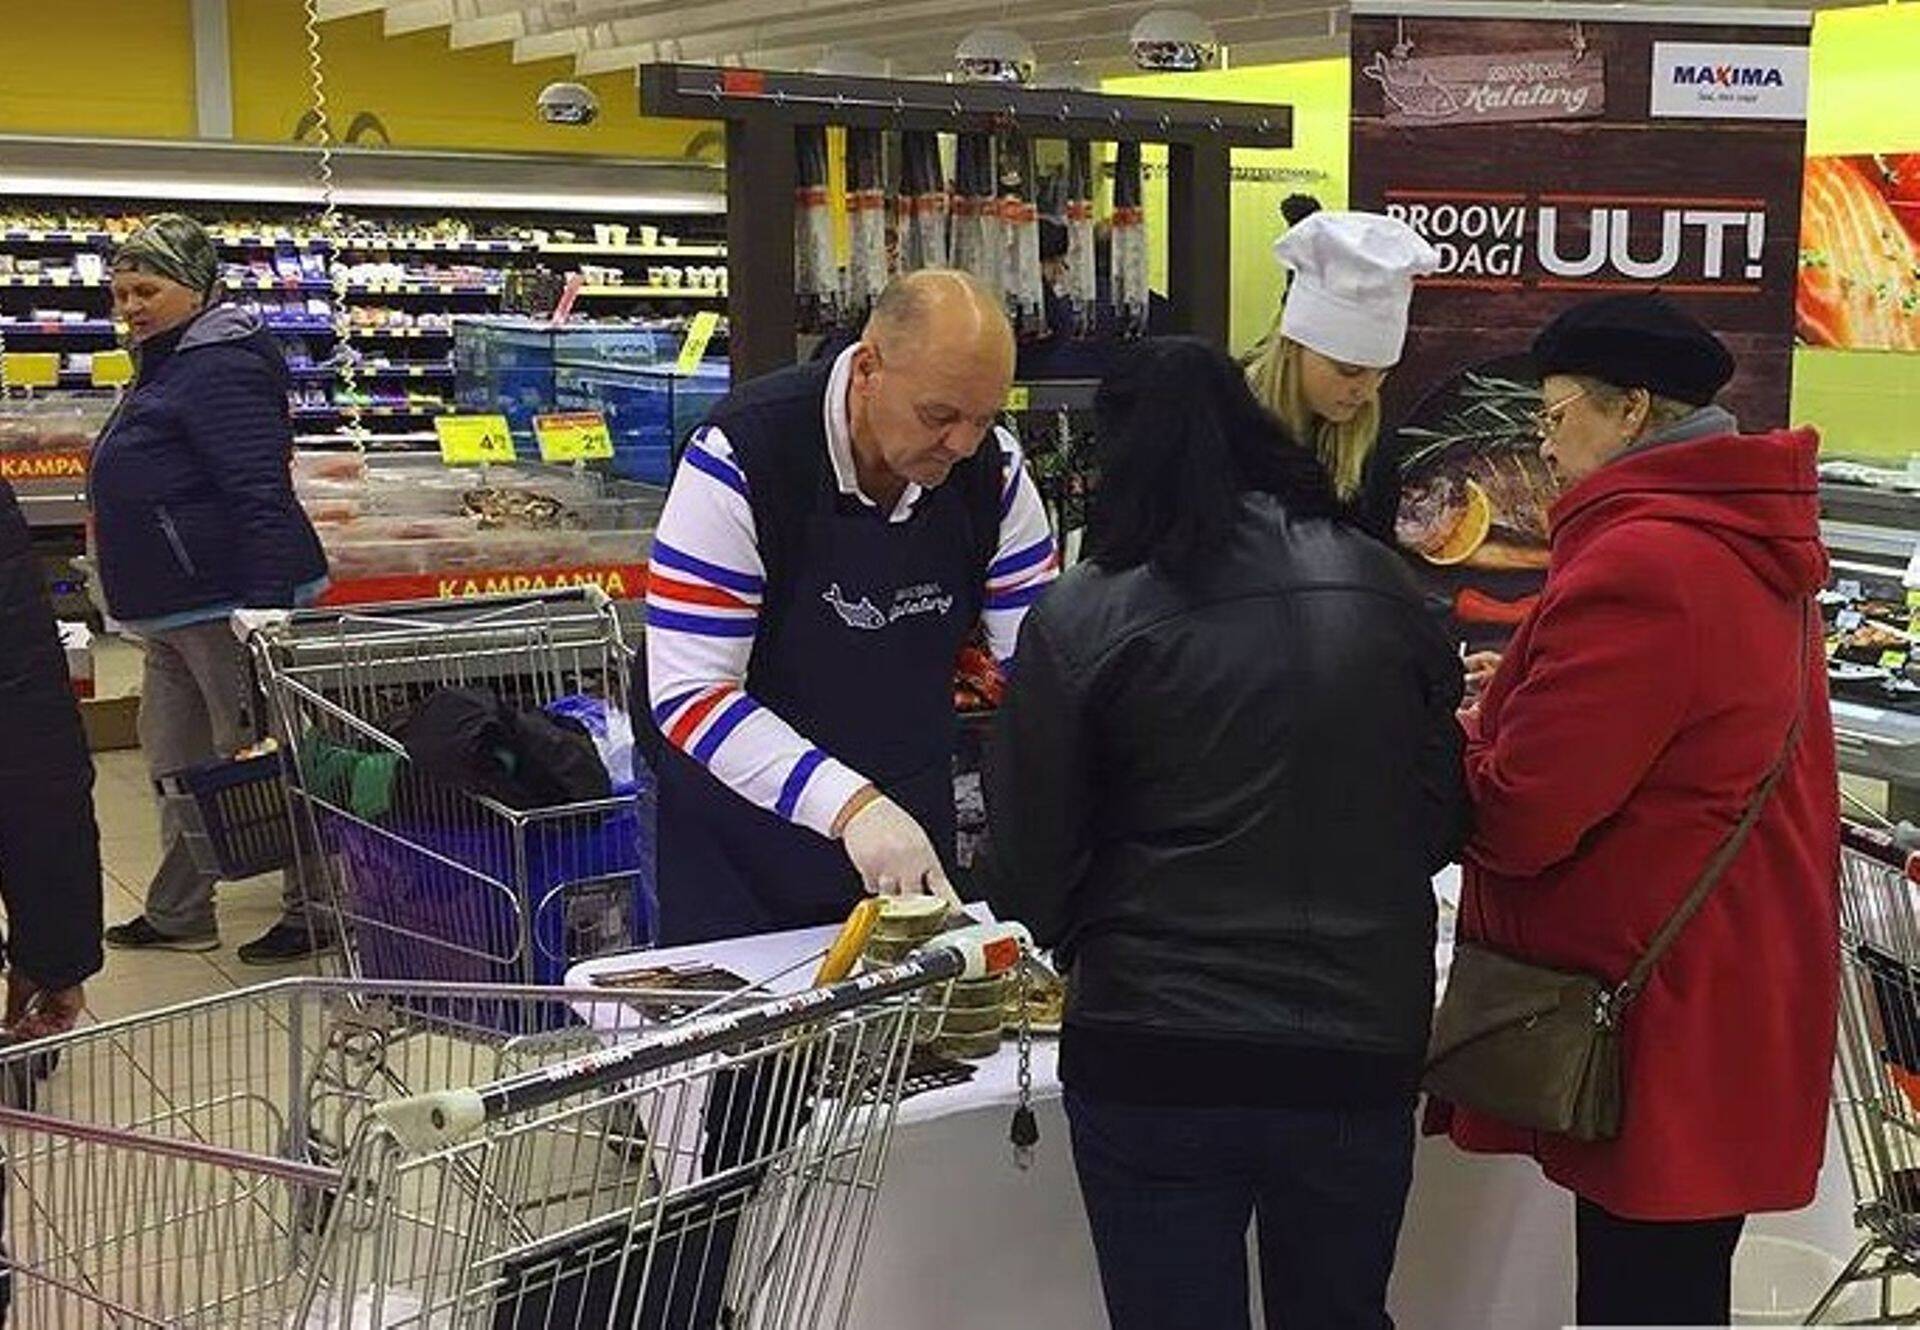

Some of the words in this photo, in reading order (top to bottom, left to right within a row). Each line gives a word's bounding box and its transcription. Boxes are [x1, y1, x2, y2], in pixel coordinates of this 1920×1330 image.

[1673, 65, 1783, 87] MAXIMA
[1387, 204, 1527, 238] PROOVI
[1434, 243, 1523, 276] DAGI
[1537, 207, 1766, 279] UUT!
[1, 457, 84, 475] KAMPA
